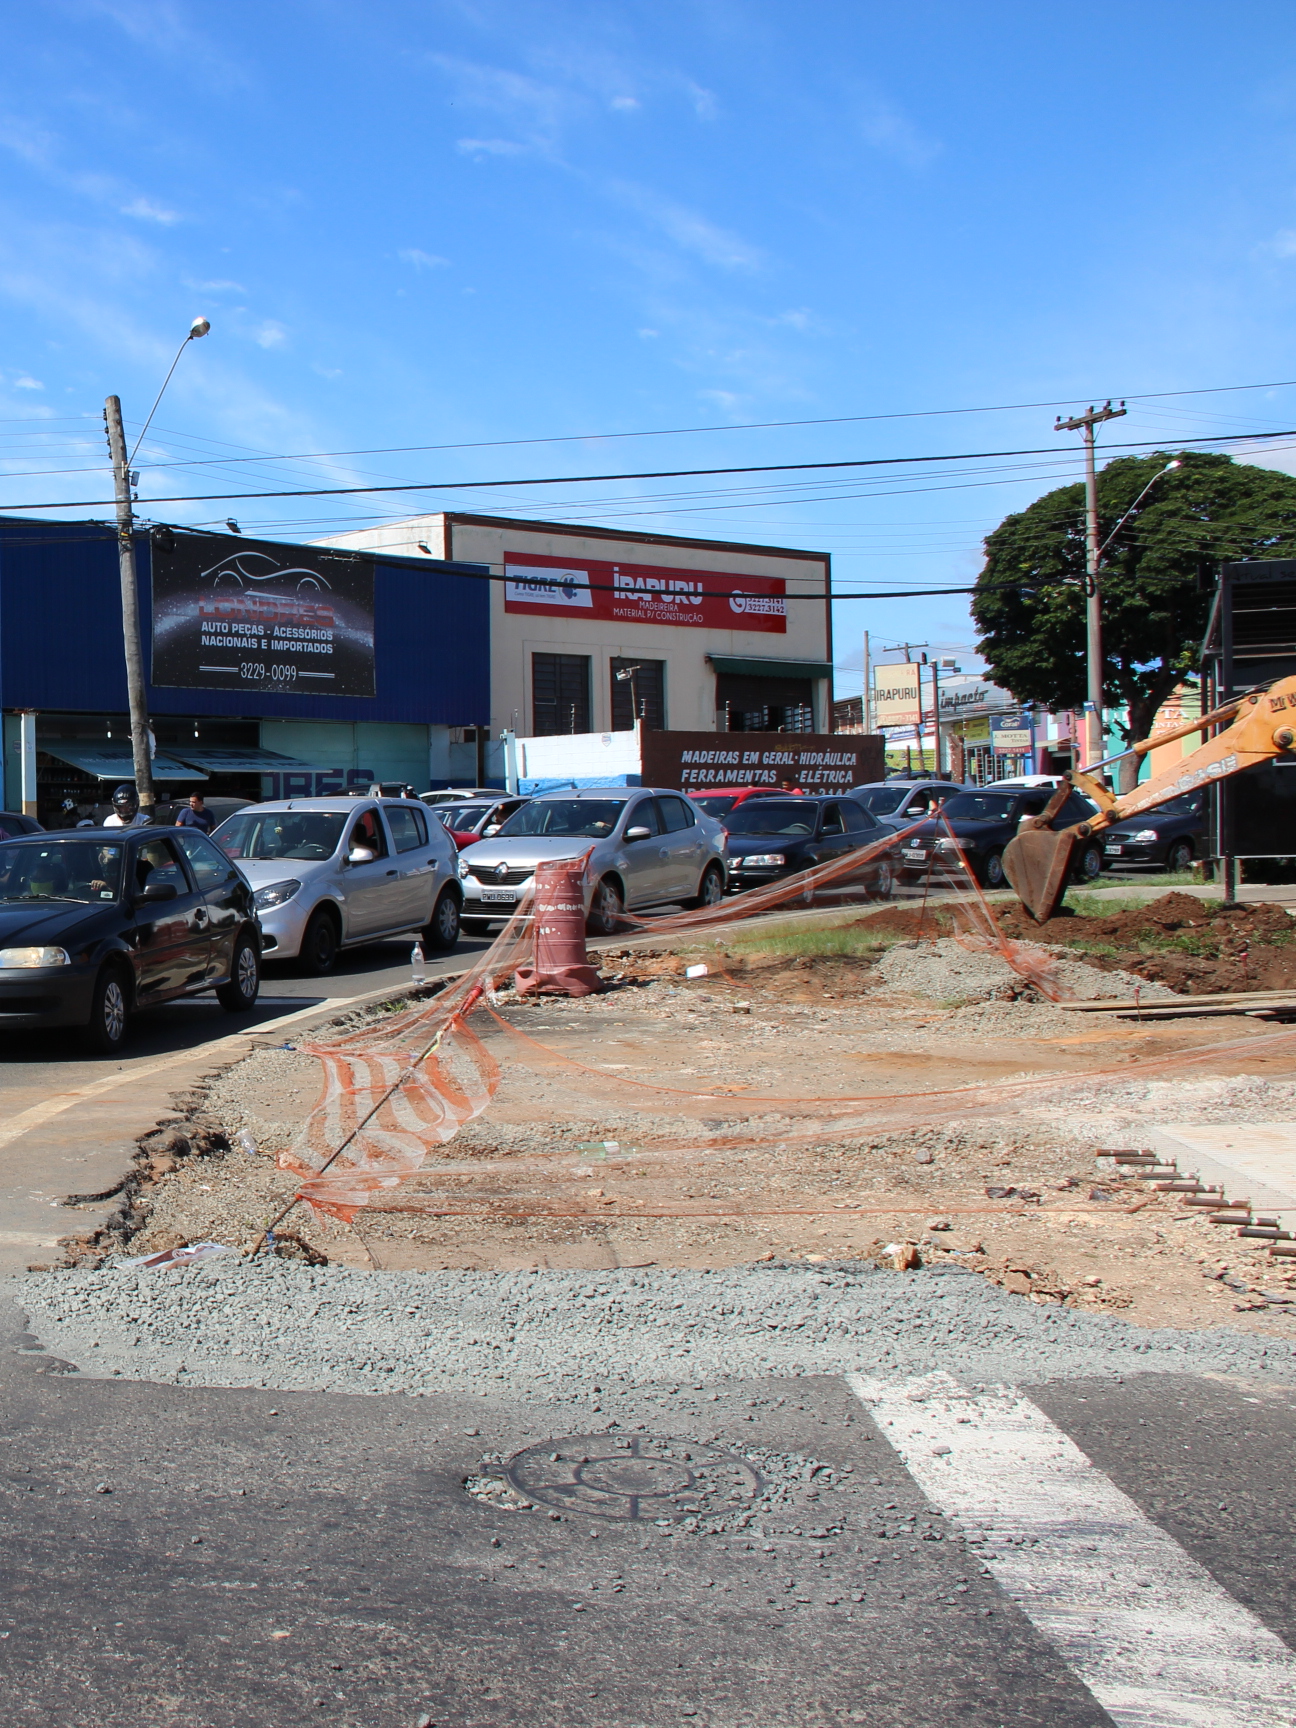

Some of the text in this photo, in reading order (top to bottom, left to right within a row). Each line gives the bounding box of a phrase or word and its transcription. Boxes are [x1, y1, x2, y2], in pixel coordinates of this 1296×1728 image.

[513, 574, 558, 593] TIGRE
[198, 595, 335, 627] LONDRES
[639, 601, 678, 611] MADEIREIRA
[613, 608, 703, 623] MATERIAL P/ CONSTRUÇÃO
[201, 621, 229, 633] AUTO
[231, 623, 265, 637] PEÇAS
[273, 625, 333, 640] ACESSÓRIOS
[201, 635, 333, 653] NACIONAIS E IMPORTADOS
[240, 662, 297, 681] 3229-0099
[876, 687, 917, 702] IRAPURU
[940, 686, 989, 712] impacto
[681, 748, 857, 766] MADEIRAS EM GERAL HIDRÁULICA
[681, 766, 854, 783] FERRAMENTAS ELÉTRICA
